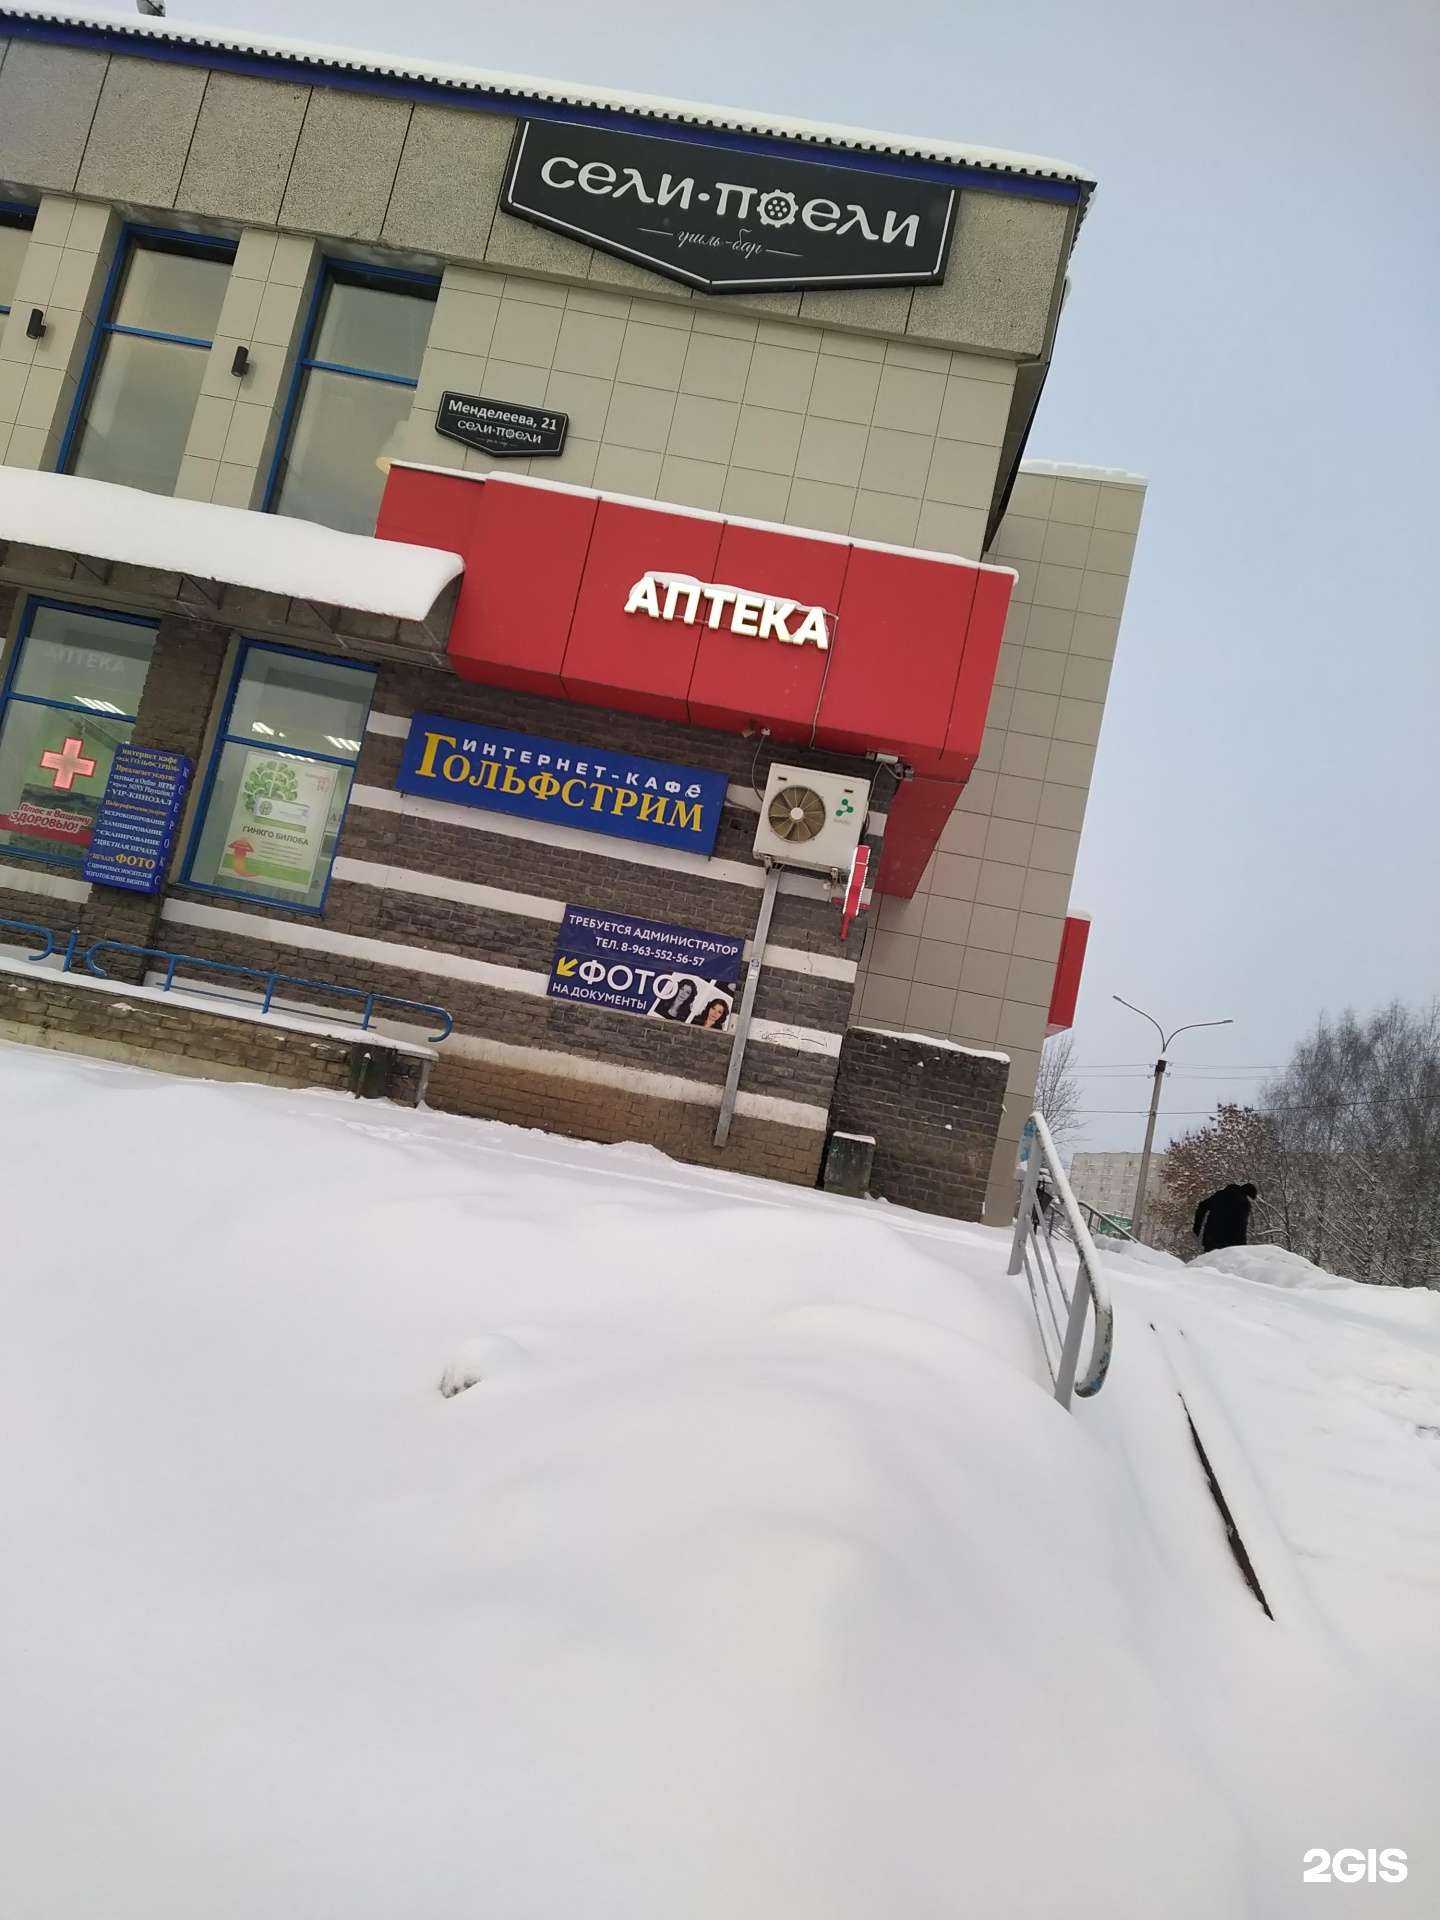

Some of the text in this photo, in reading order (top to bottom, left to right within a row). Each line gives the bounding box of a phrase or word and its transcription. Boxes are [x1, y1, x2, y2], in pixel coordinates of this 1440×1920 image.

[448, 400, 557, 430] Менделеева, 21
[624, 576, 829, 650] АПТЕКА
[415, 731, 704, 832] ГОЛЬФСТРИМ
[115, 853, 156, 870] ФОТО
[569, 914, 739, 956] ТРЕБУЕТСЯ АДМИНИСТРАТОР
[595, 937, 705, 967] ТЕЛ. 8-963-552-56-57
[553, 982, 648, 1010] НА ДОКУМЕНТЫ
[579, 959, 679, 1000] ФОТО
